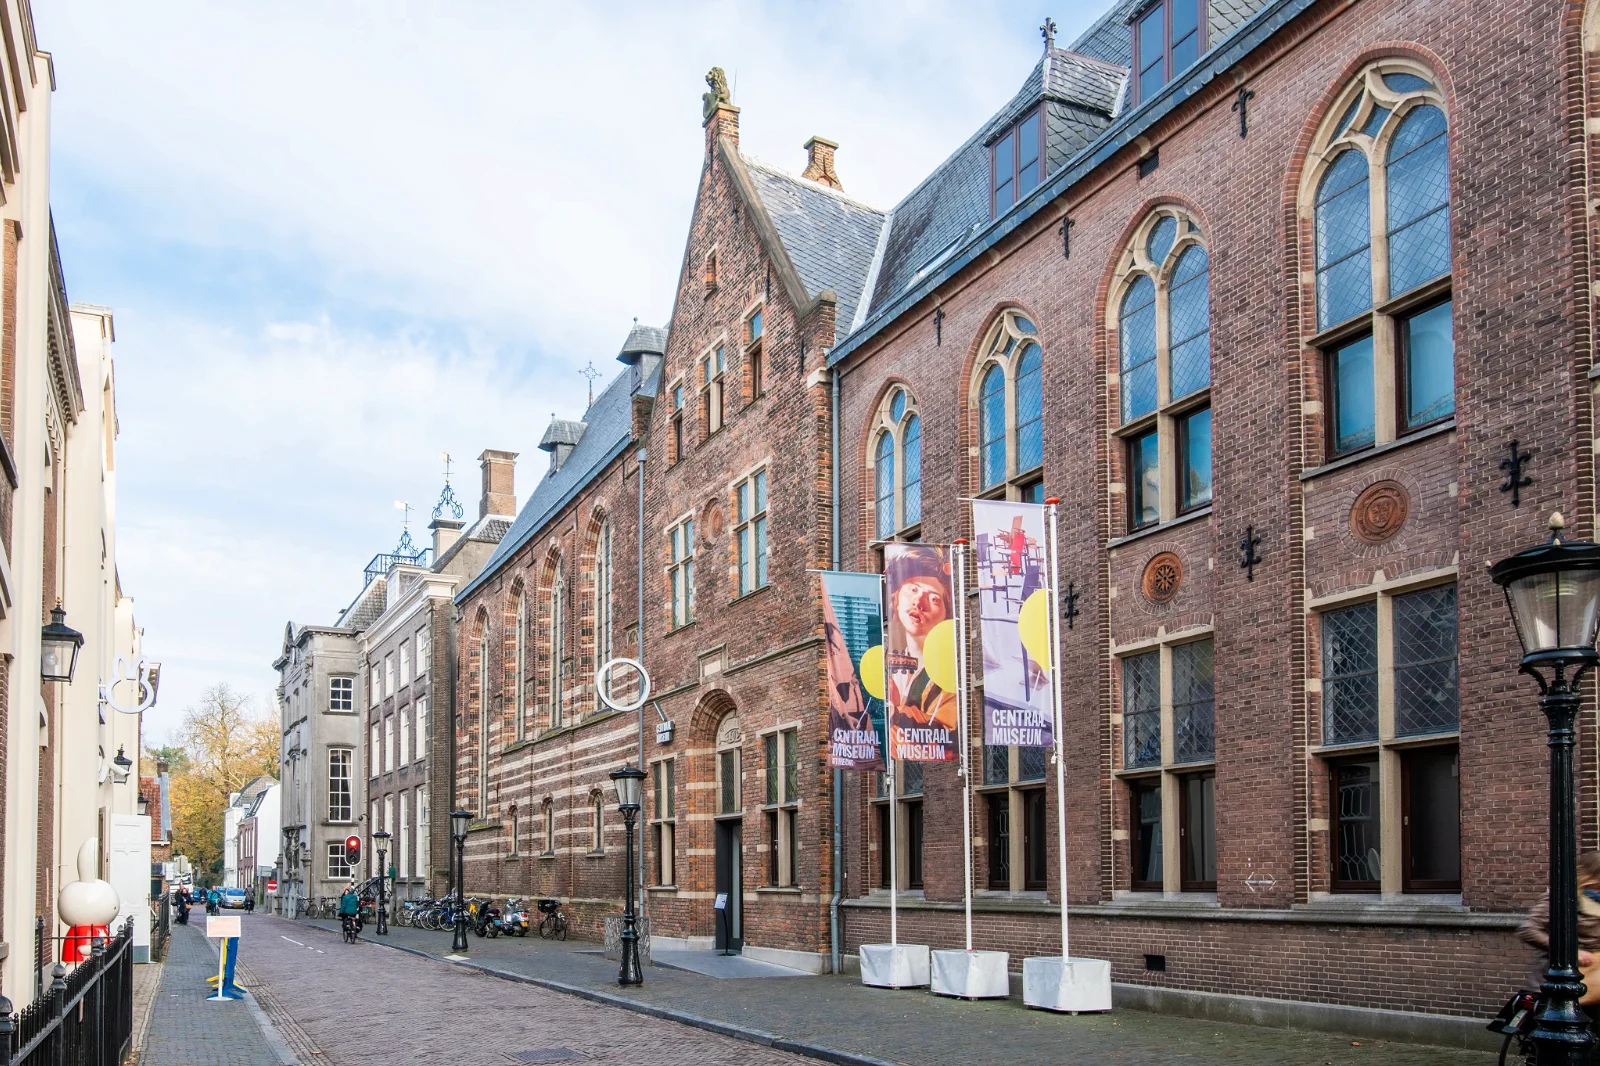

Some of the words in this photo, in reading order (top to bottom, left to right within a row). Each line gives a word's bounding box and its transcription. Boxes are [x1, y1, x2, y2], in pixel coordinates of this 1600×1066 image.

[834, 728, 881, 744] CENTRAAL
[897, 728, 953, 743] CENTRAAL
[992, 727, 1042, 745] MUSEUM
[832, 743, 875, 759] MUSEUM
[897, 744, 946, 760] MUSEUM
